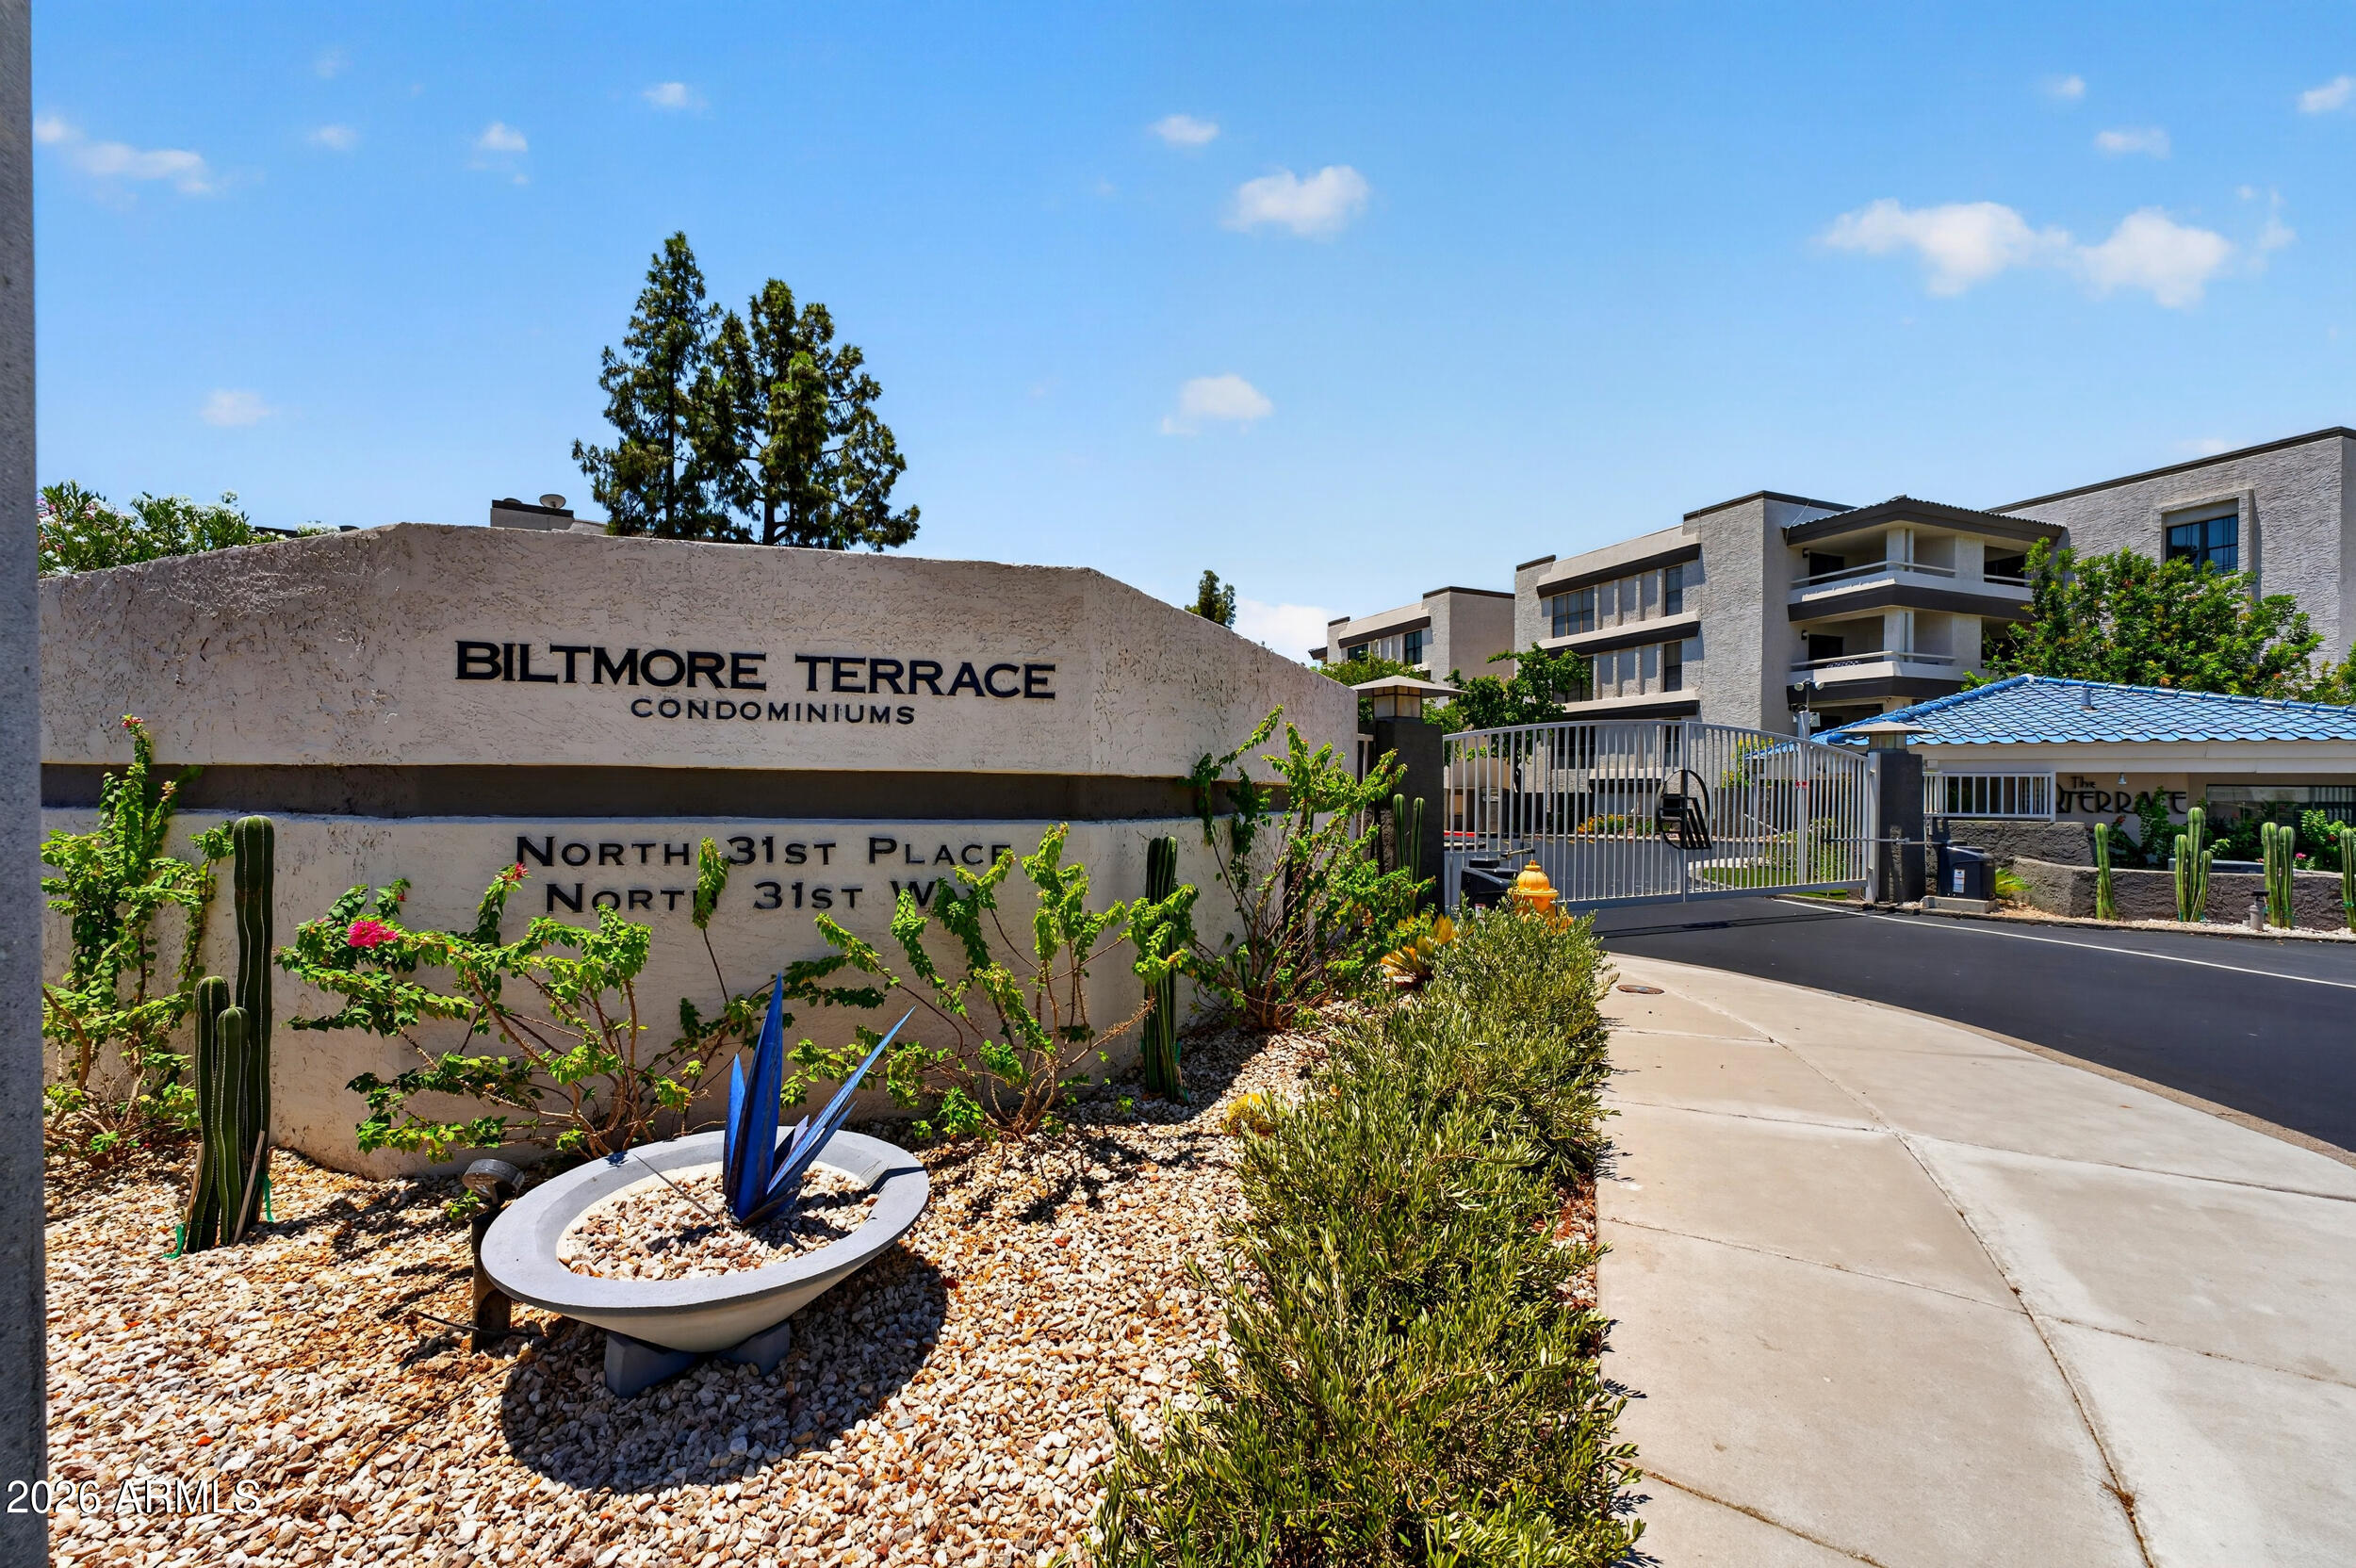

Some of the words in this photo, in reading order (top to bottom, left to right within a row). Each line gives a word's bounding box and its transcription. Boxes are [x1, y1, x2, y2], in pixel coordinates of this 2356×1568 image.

[455, 641, 767, 692] BILTMORE
[795, 654, 1056, 701] TERRACE
[630, 698, 915, 726] CONDOMINIUMS
[2063, 790, 2187, 815] TERRE
[515, 837, 690, 867] NORTH
[727, 836, 837, 866] 31ST
[752, 882, 863, 911] 31ST
